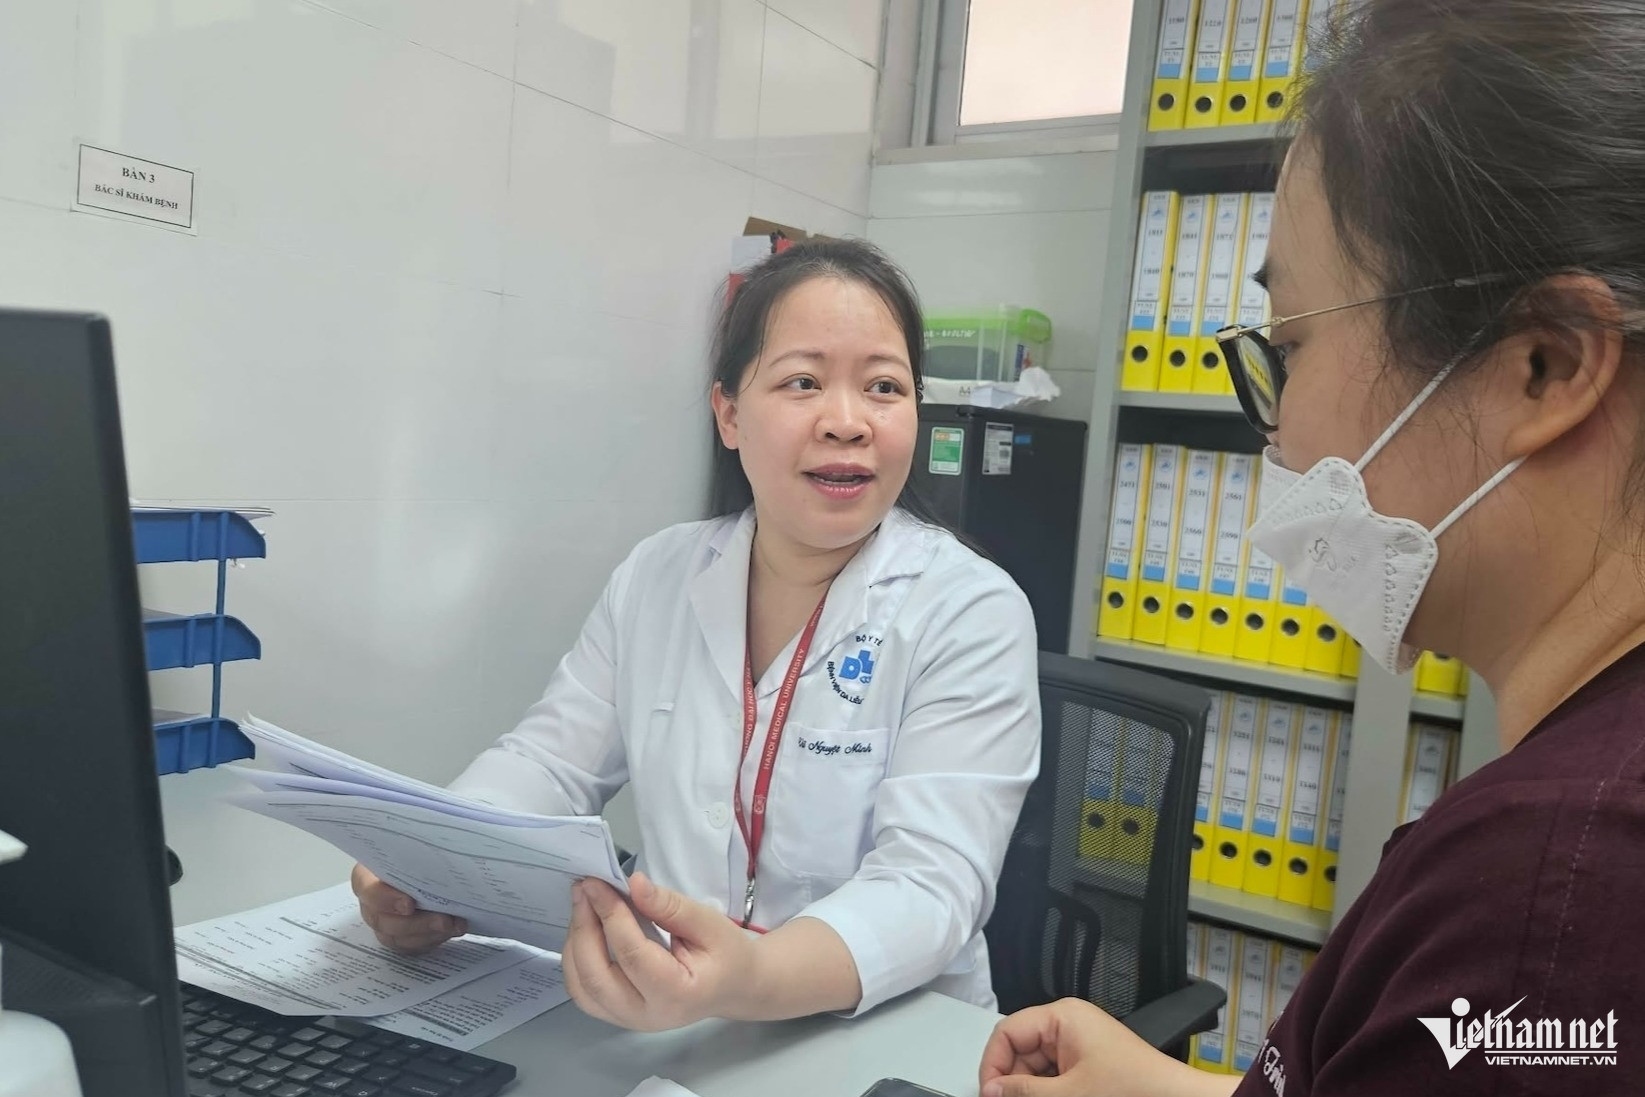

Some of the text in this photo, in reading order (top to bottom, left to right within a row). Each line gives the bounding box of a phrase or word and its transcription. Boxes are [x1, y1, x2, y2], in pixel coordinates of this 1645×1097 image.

[148, 174, 155, 184] 3
[764, 648, 805, 770] HANOI MEDICAL UNIVERSITY
[844, 742, 872, 754] Minh
